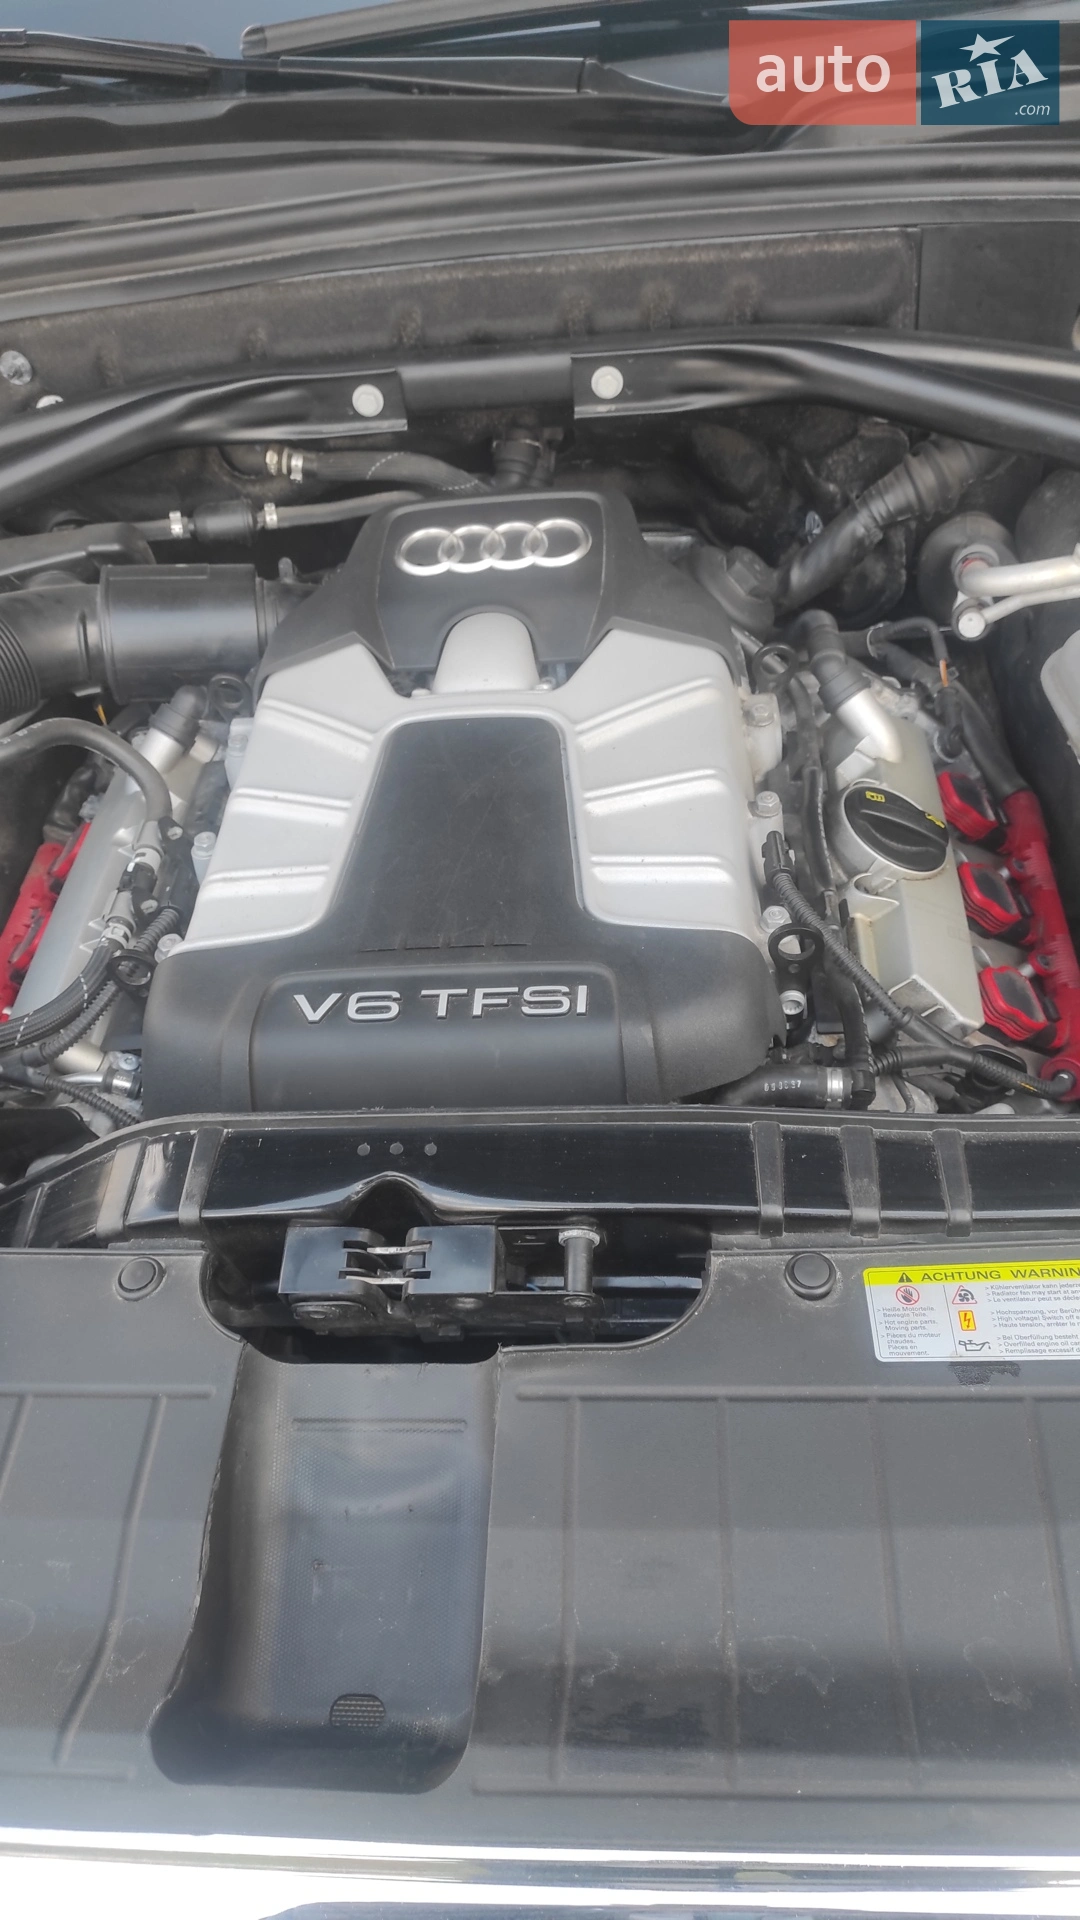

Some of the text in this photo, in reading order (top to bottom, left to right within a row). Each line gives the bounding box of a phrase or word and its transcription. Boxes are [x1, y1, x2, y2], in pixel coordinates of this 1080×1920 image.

[293, 985, 588, 1024] V6 TFSI
[921, 1270, 1001, 1282] ACHTUNG
